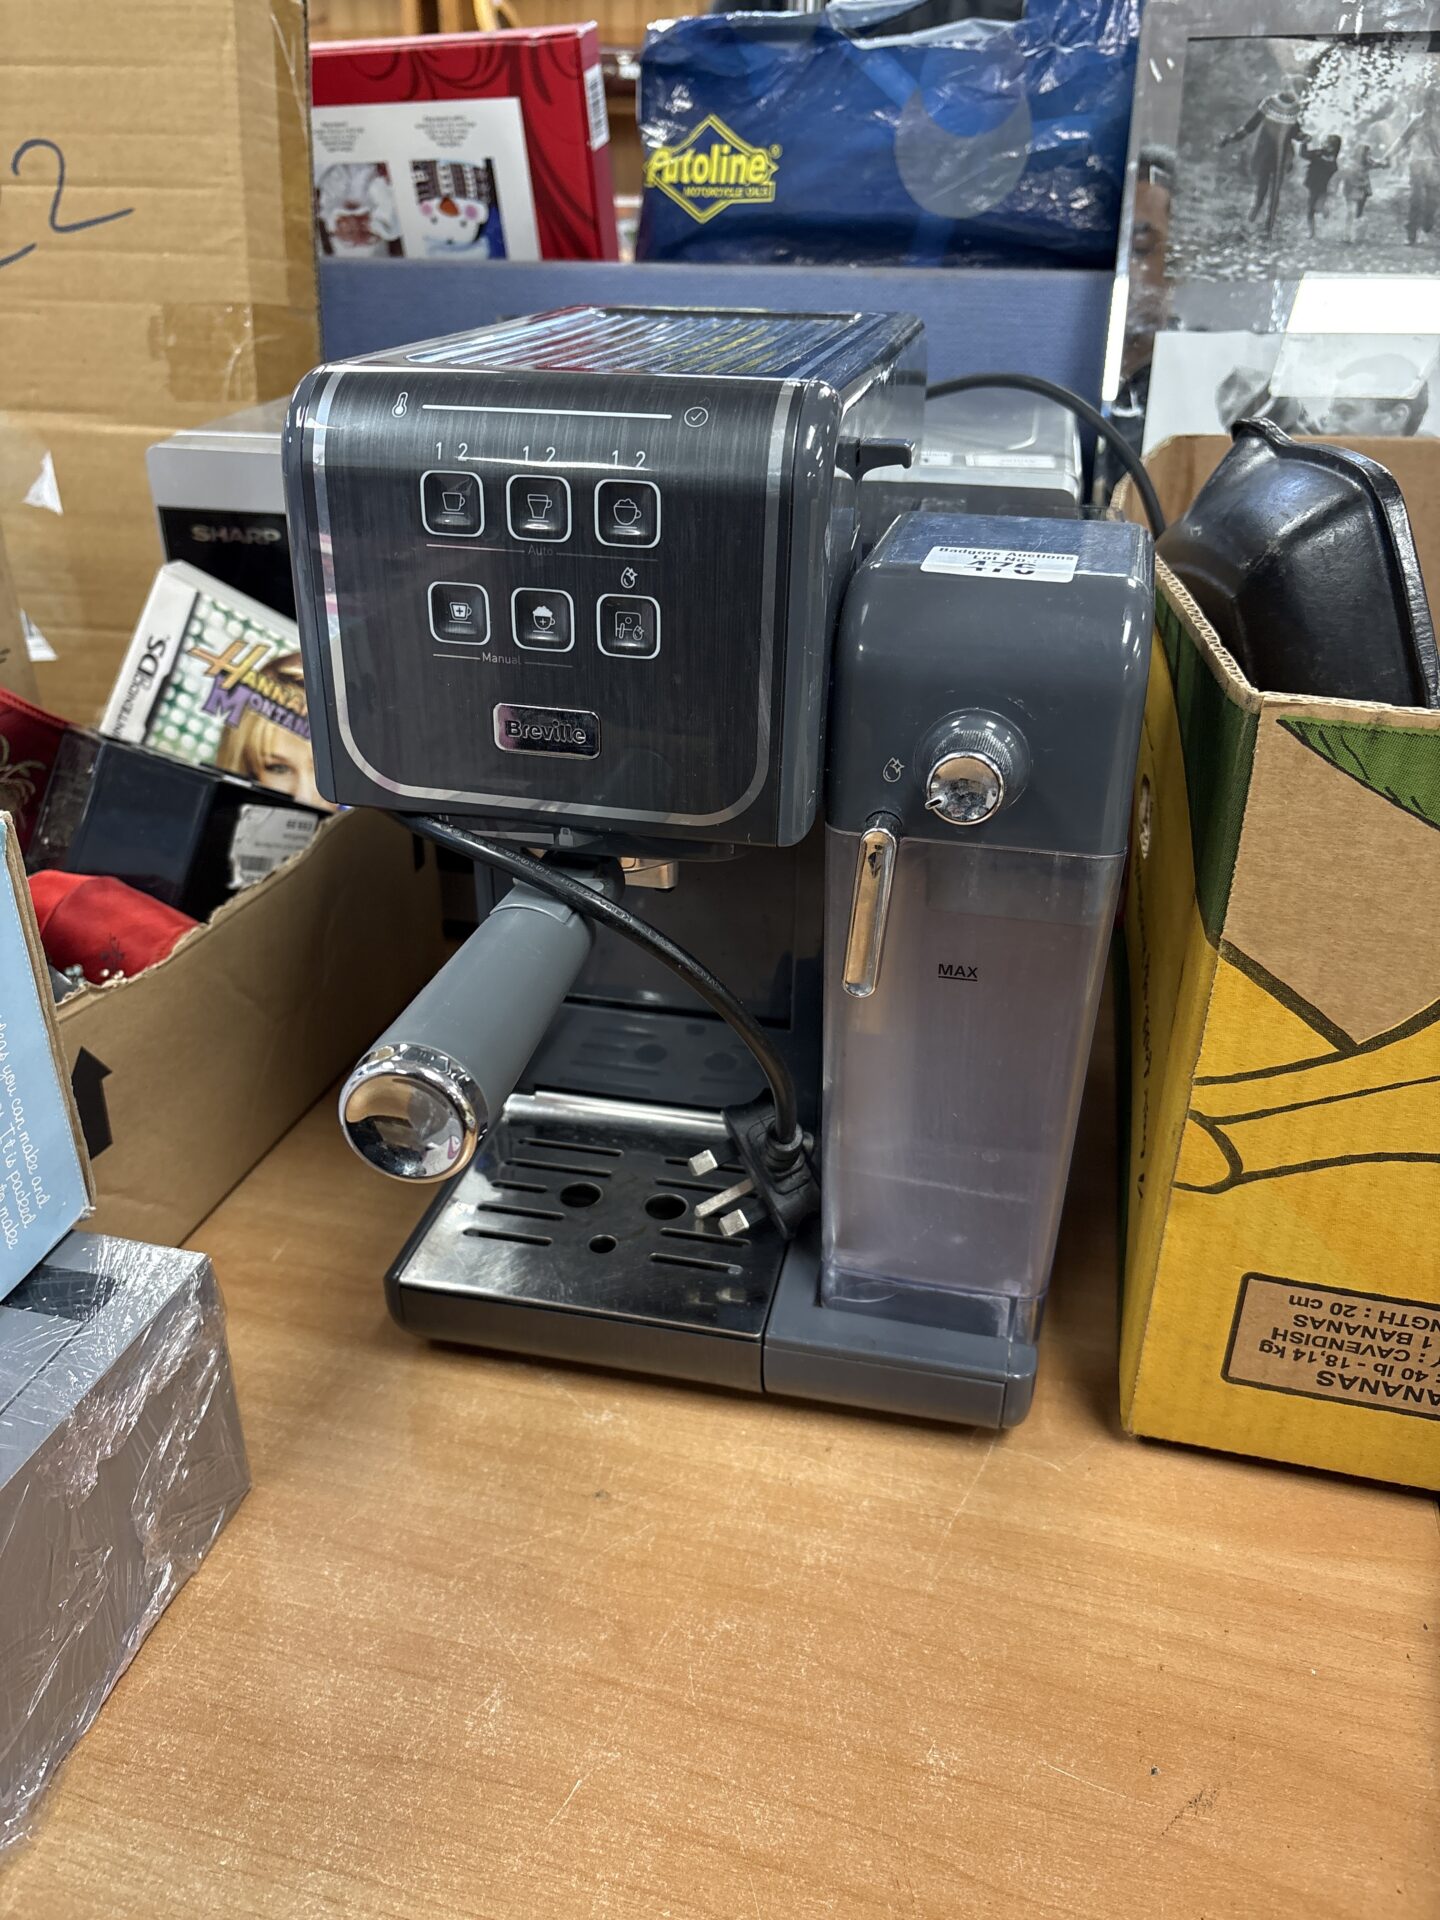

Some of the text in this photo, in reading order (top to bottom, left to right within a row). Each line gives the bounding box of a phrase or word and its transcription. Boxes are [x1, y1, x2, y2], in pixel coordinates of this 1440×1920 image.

[11, 138, 134, 233] 2
[435, 441, 469, 461] 1 2
[523, 445, 556, 464] 1 2
[611, 450, 646, 469] 1 2
[191, 524, 282, 545] SHARP
[528, 544, 553, 556] Auto
[938, 547, 1074, 561] Badgers Auctions
[963, 560, 1036, 575] 476
[139, 635, 166, 677] DS
[482, 651, 521, 665] Manual
[187, 640, 310, 718] HANNA
[505, 718, 587, 744] Breville
[938, 963, 978, 979] MAX
[0, 1064, 17, 1097] you
[11, 1098, 25, 1130] can
[19, 1131, 39, 1175] make
[31, 1176, 51, 1209] and
[5, 1151, 17, 1168] is
[6, 1170, 36, 1229] packed
[0, 1206, 19, 1250] make
[1288, 1294, 1323, 1310] cm
[1330, 1302, 1358, 1318] 20
[1293, 1313, 1433, 1349] 1 BANANAS
[1259, 1339, 1286, 1359] kg
[1271, 1327, 1411, 1362] CAVENDISH
[1292, 1348, 1350, 1369] 18,14
[1373, 1362, 1395, 1378] lb
[1401, 1367, 1429, 1383] 40
